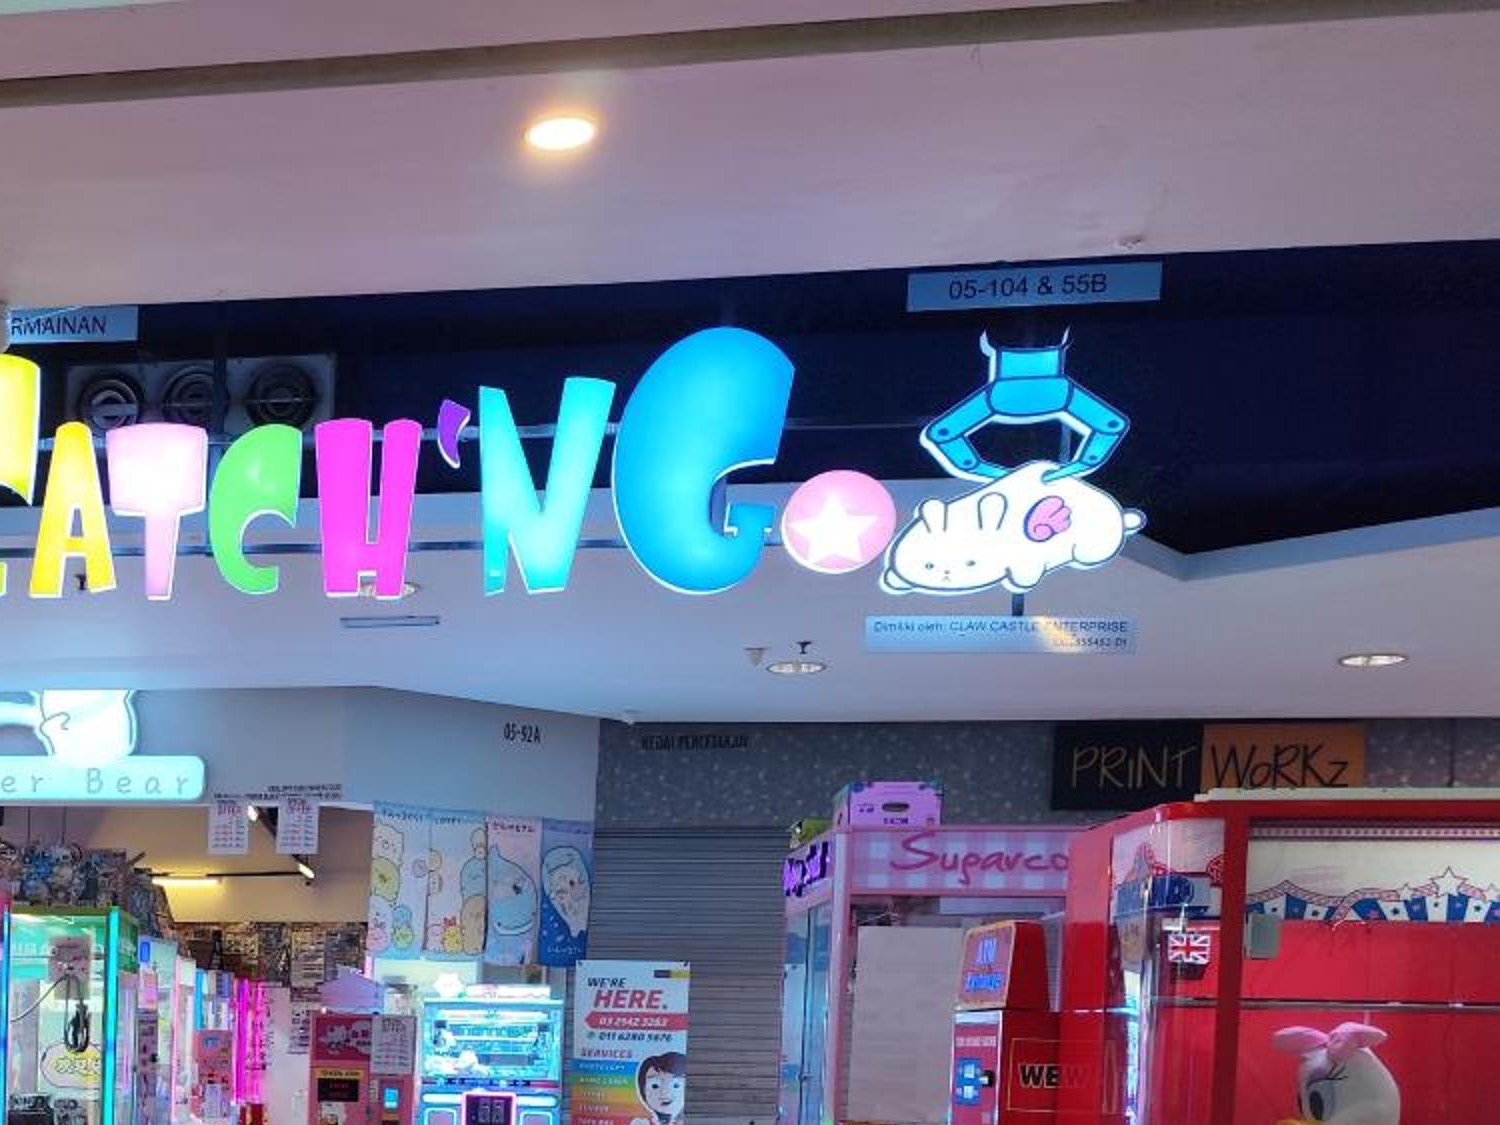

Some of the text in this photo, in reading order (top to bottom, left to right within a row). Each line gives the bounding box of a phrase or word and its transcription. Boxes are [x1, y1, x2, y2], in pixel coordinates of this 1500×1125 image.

[948, 273, 1108, 299] 05-104 & 55B
[10, 316, 107, 337] RMAINAN
[949, 620, 986, 633] CLAW
[85, 765, 191, 794] Bear
